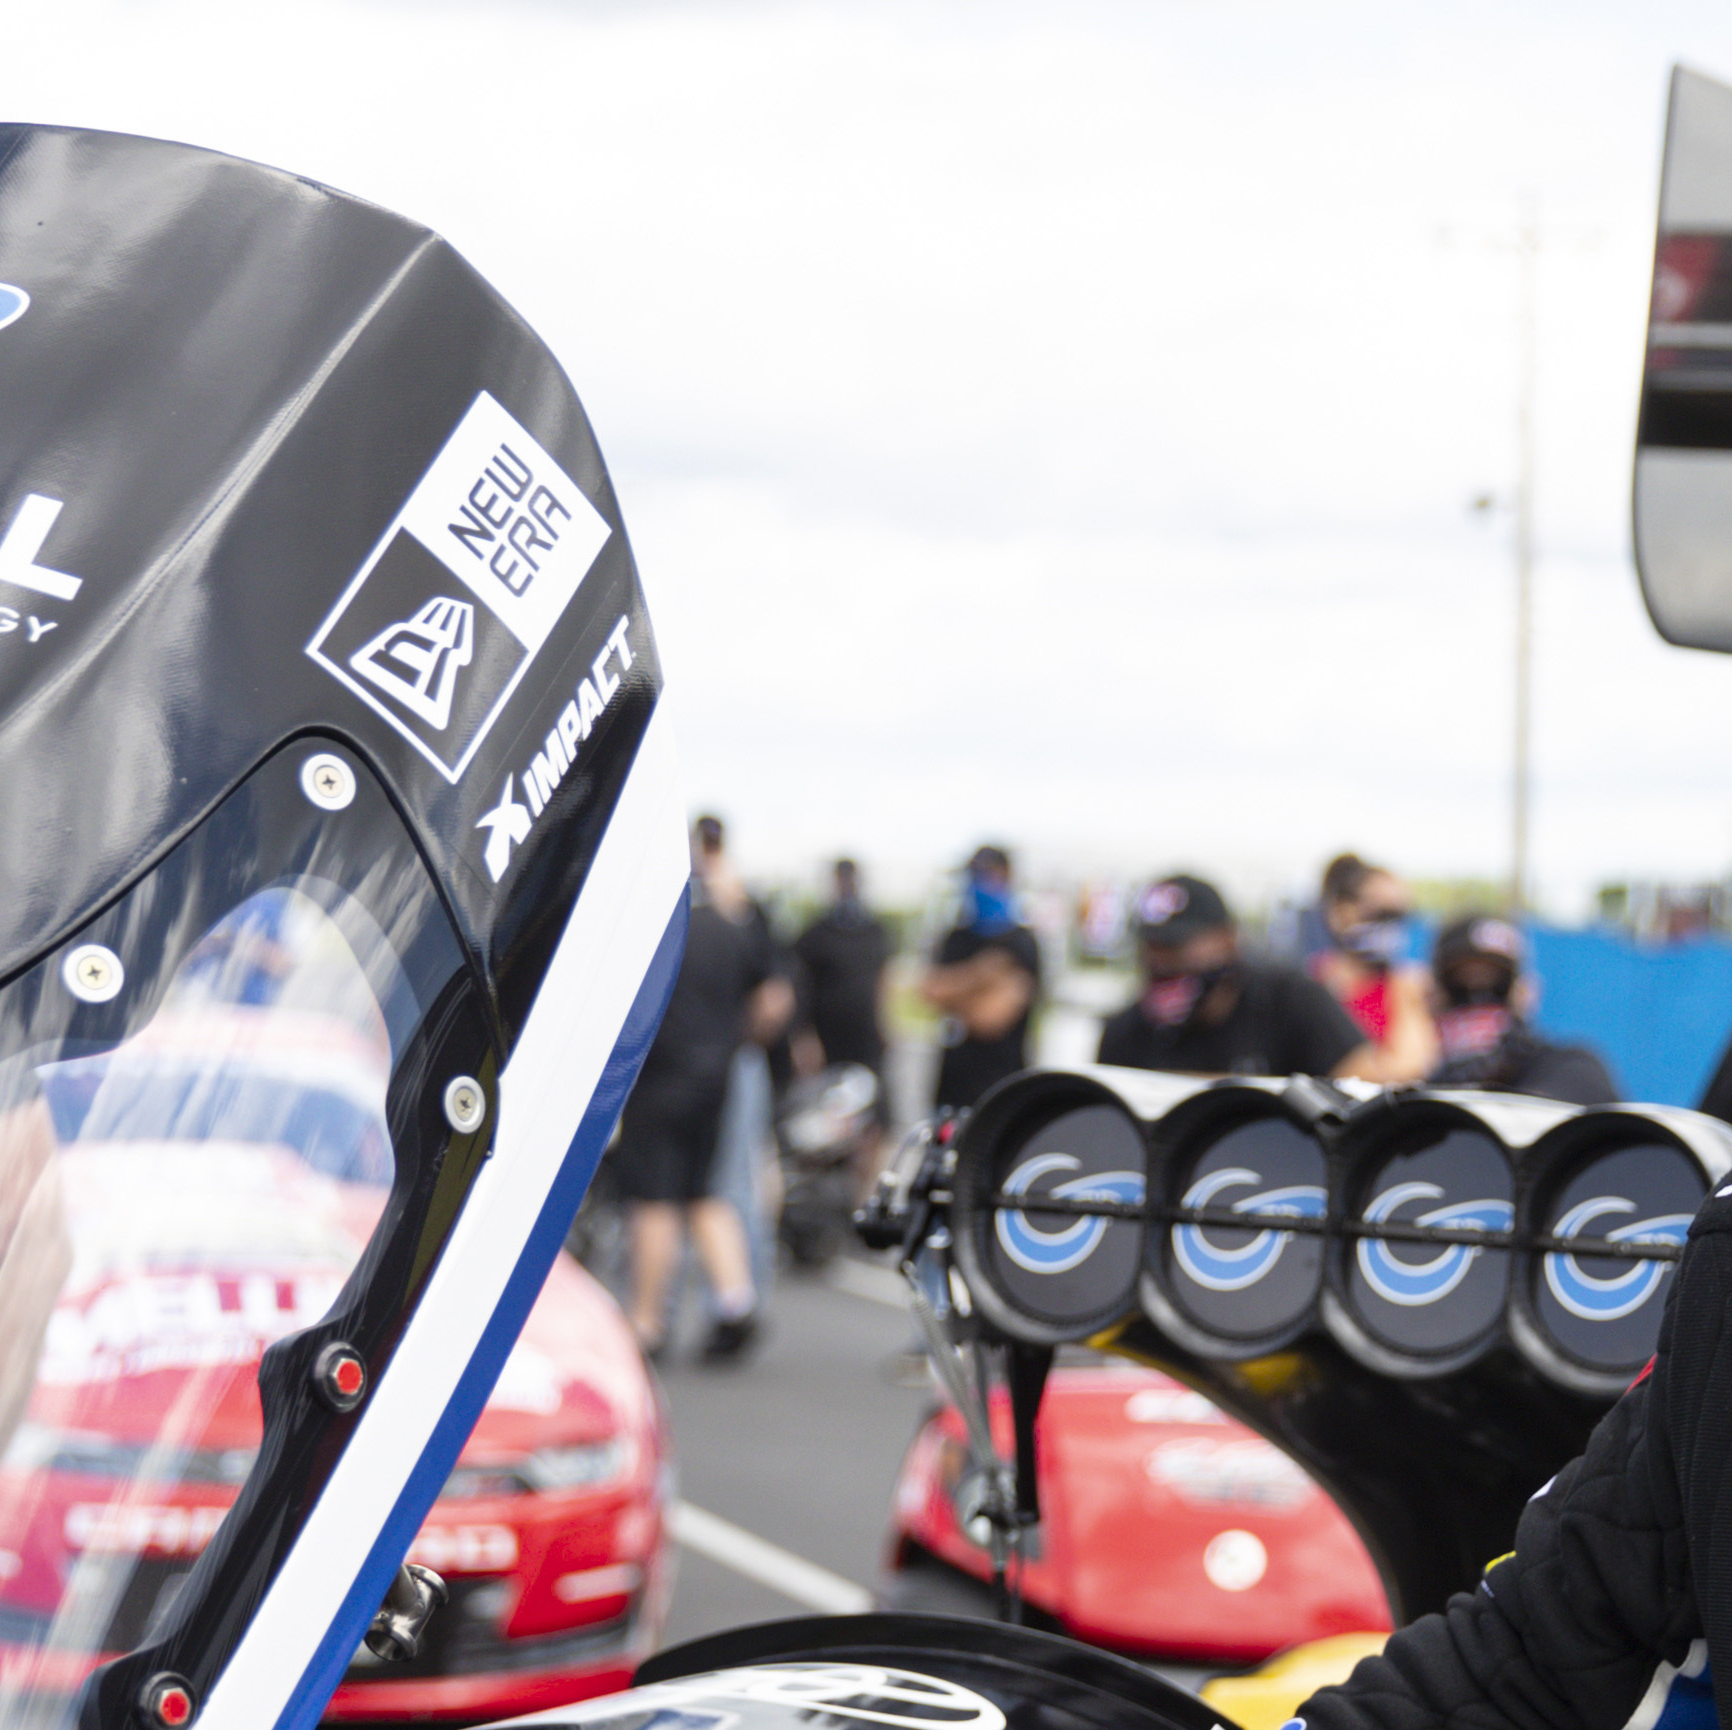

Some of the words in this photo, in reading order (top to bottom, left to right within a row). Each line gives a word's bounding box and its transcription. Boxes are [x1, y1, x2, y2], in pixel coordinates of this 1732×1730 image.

[447, 442, 535, 561] NEW
[488, 484, 573, 599] ERA
[521, 613, 635, 818] IMPACT
